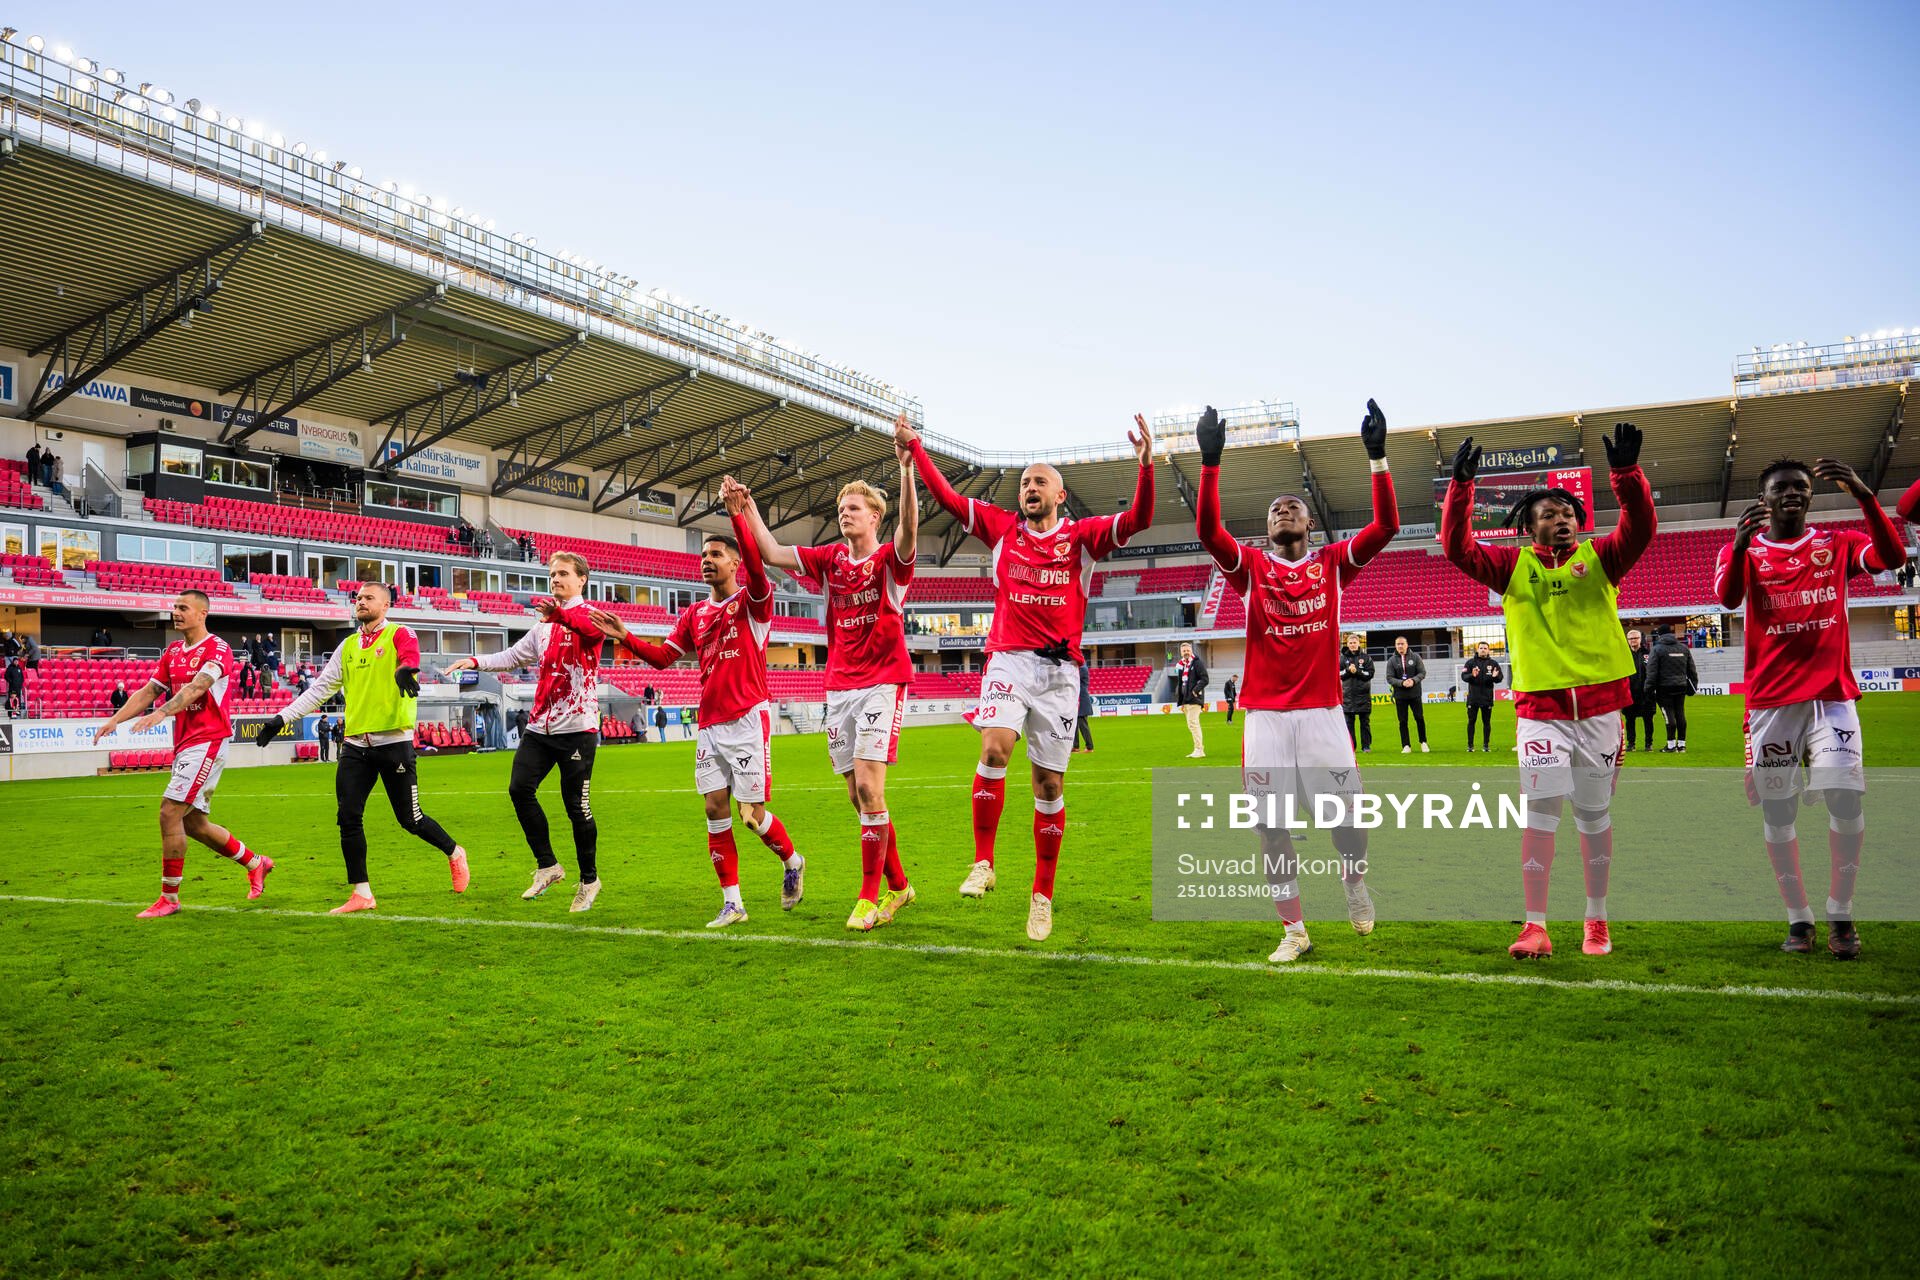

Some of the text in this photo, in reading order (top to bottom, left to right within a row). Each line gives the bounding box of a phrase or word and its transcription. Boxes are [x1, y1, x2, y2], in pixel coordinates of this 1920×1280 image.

[47, 374, 128, 402] YAKAWA
[301, 423, 347, 442] NYBROGRUS
[1478, 449, 1546, 468] ldFågeln
[406, 458, 456, 478] Kalmar län
[1556, 471, 1581, 480] 94:04
[1575, 481, 1582, 489] 2
[1480, 528, 1515, 537] KVANTUM
[1008, 563, 1070, 585] MULTIBYGG
[1264, 620, 1328, 636] ALEMTEK
[1765, 614, 1837, 636] ALEMTEK
[1874, 670, 1889, 678] DIN
[982, 705, 997, 721] 23
[28, 727, 64, 739] STENA
[85, 727, 118, 737] STA
[1520, 754, 1560, 770] Nybloms
[1530, 773, 1538, 789] 7
[1766, 775, 1783, 790] 20
